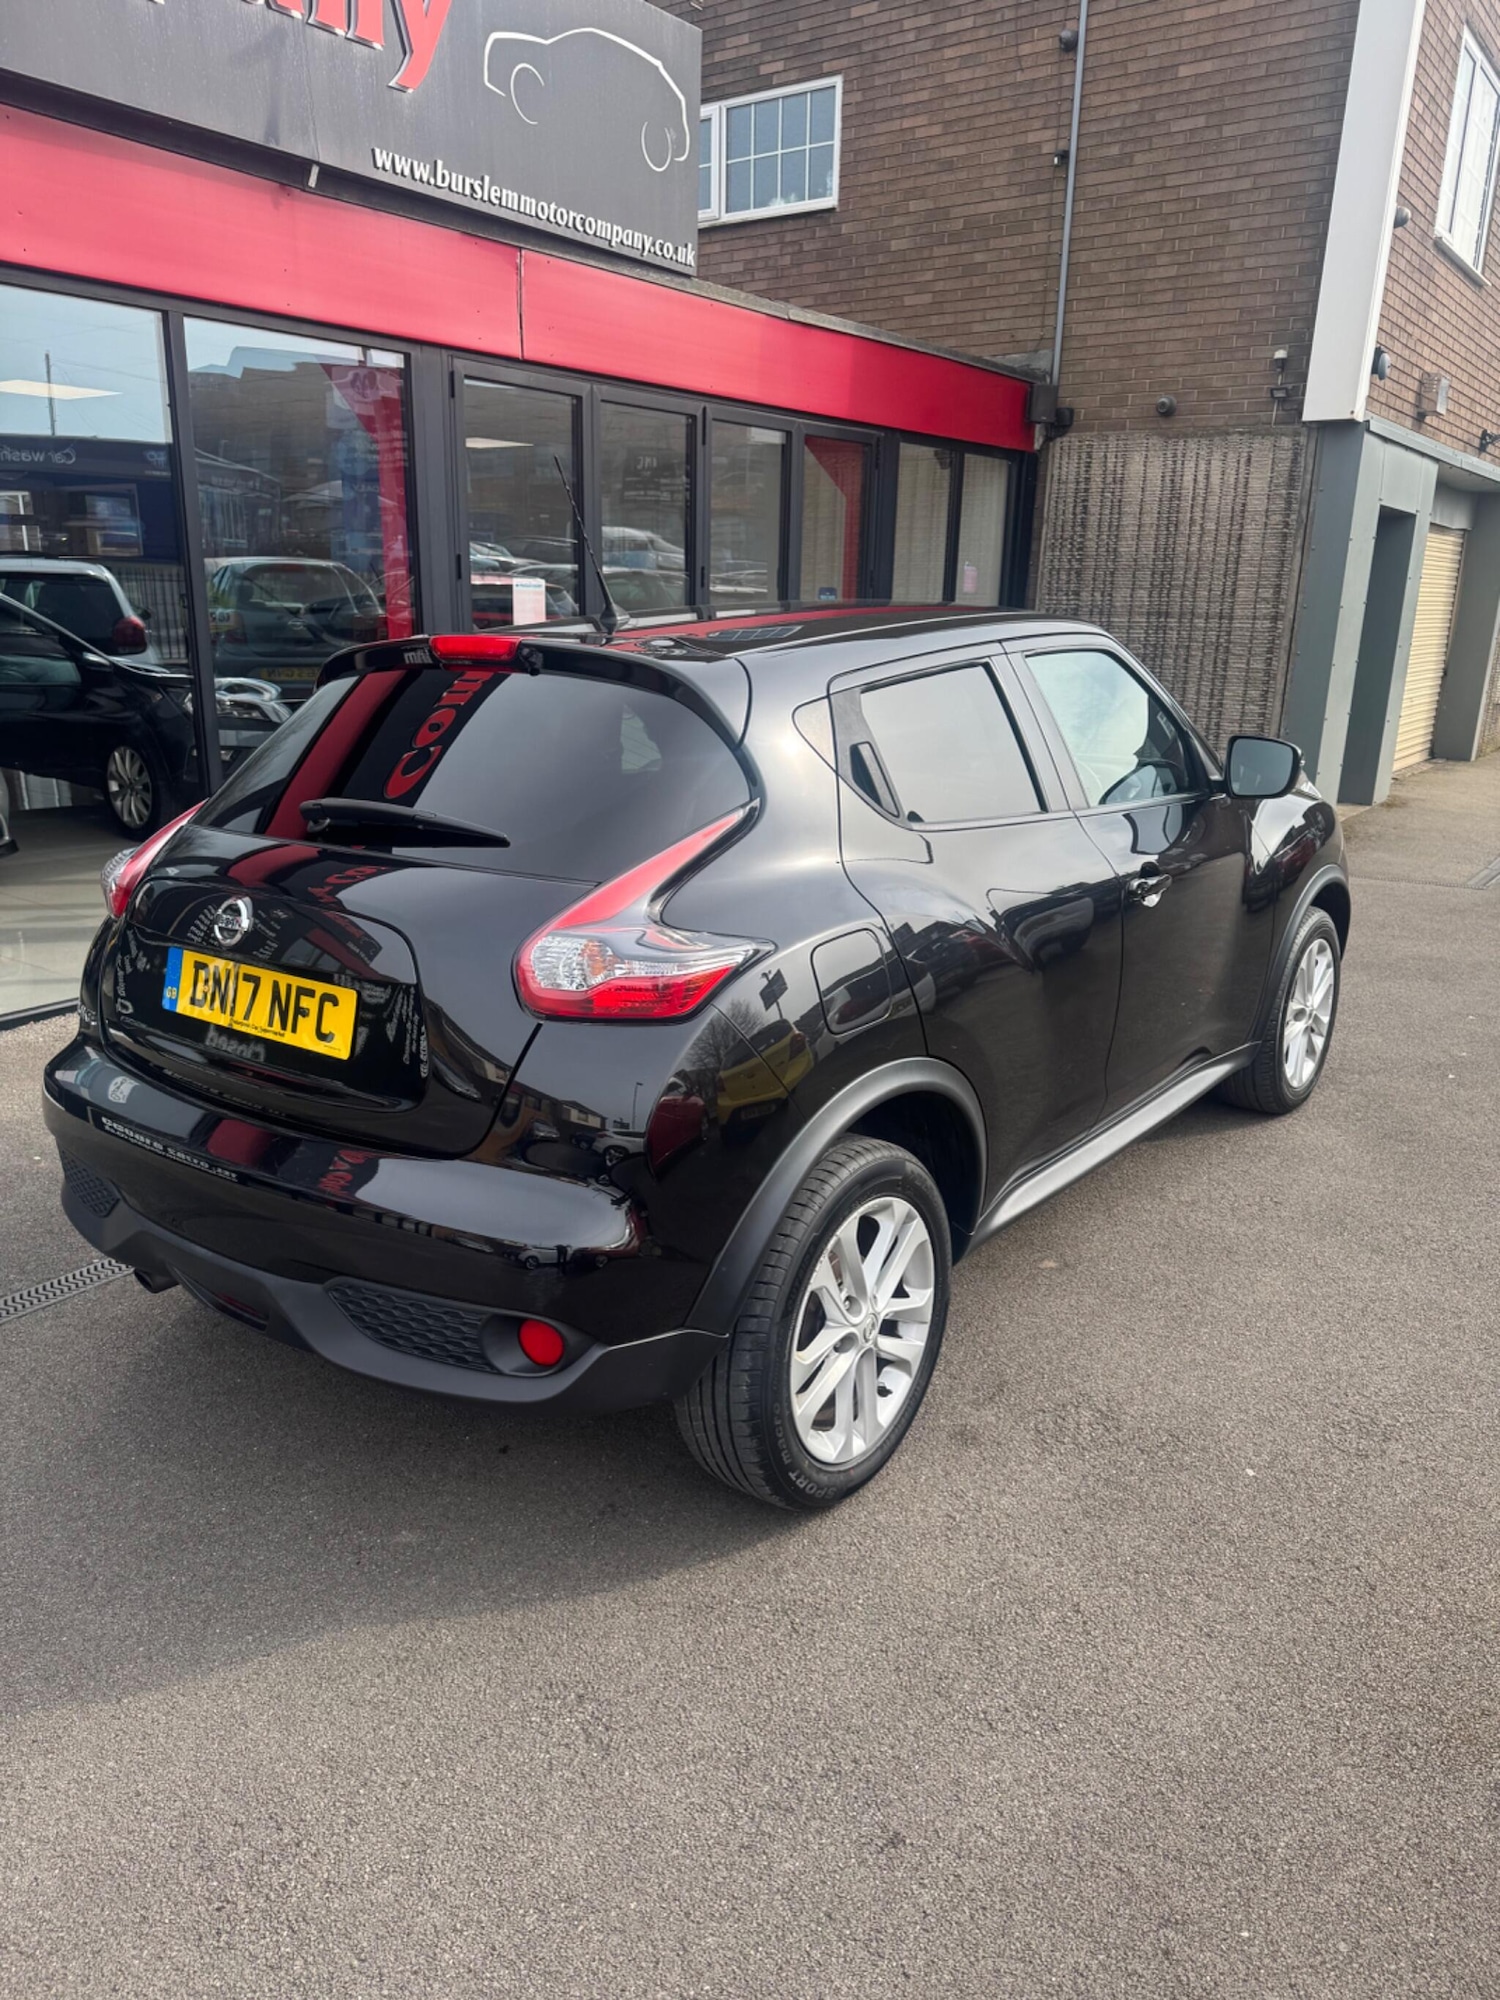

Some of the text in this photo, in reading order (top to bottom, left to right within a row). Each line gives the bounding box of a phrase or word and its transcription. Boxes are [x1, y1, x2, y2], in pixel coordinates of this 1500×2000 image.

[372, 147, 696, 267] www.burslemmotorcompany.co.uk
[189, 960, 262, 1021] DN17
[267, 979, 340, 1043] NFC
[788, 1470, 837, 1499] SPORT
